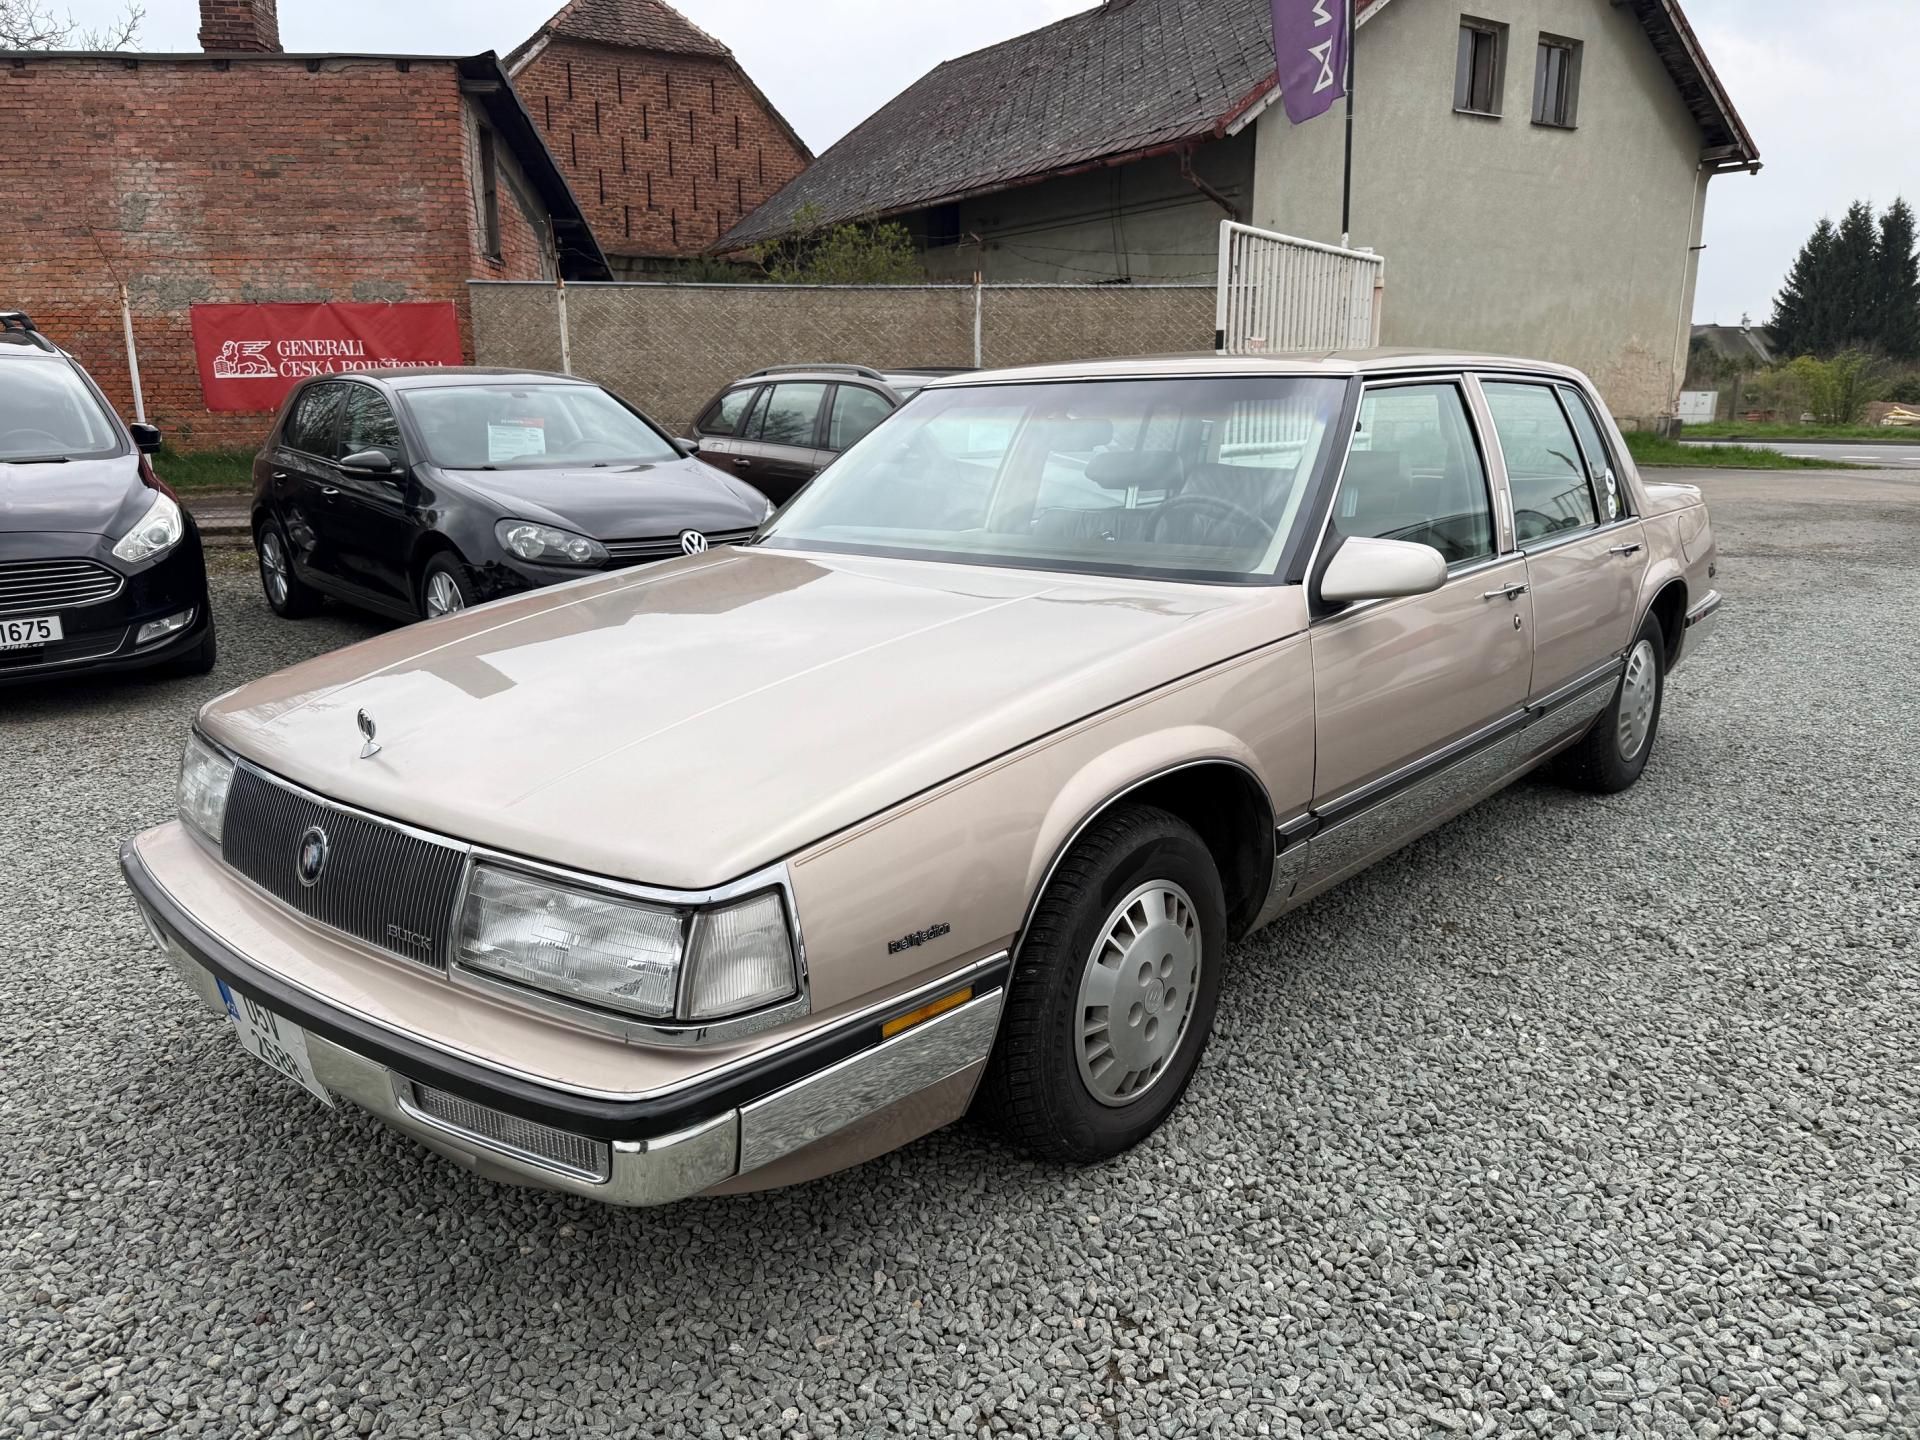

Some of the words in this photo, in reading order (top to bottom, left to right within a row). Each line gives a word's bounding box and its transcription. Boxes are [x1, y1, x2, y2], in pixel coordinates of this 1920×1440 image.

[276, 339, 365, 356] GENERALI
[279, 358, 335, 377] ČESKÁ
[0, 619, 51, 643] 1675
[387, 924, 432, 950] BUICK
[250, 1028, 305, 1083] 2688
